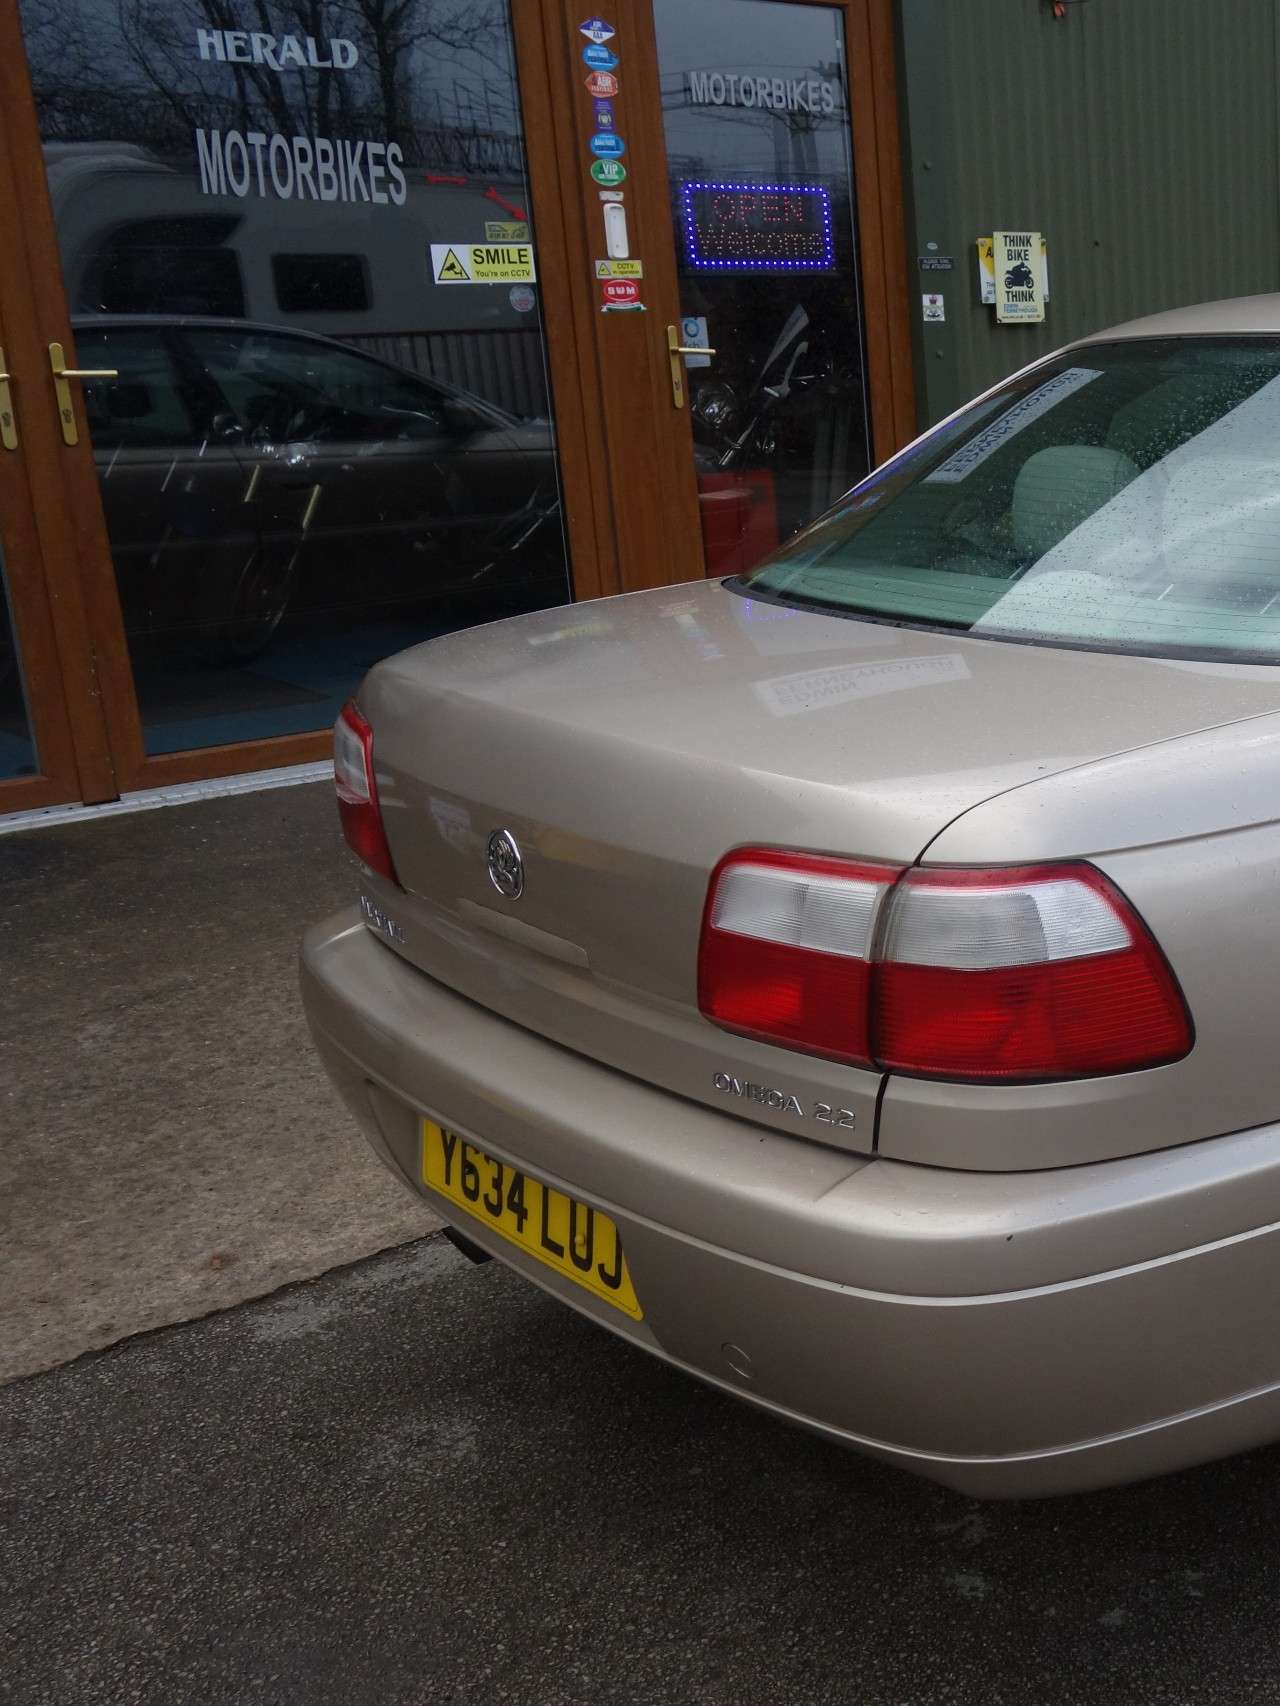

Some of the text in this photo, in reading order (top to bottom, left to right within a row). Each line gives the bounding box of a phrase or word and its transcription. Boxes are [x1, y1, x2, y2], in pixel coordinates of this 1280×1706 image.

[196, 28, 359, 71] HERALD
[689, 71, 834, 113] MOTORBIKES
[196, 128, 407, 206] MOTORBIKES
[712, 193, 805, 223] OPEN
[695, 223, 824, 256] Welcome
[1003, 235, 1033, 248] THINK
[473, 248, 530, 265] SMILE
[616, 262, 634, 270] CCTV
[1007, 249, 1030, 261] BIKE
[476, 270, 498, 278] You're
[510, 269, 531, 277] CCTV
[1005, 290, 1035, 303] THINK
[713, 1072, 805, 1116] OMEGA
[440, 1127, 529, 1235] Y634
